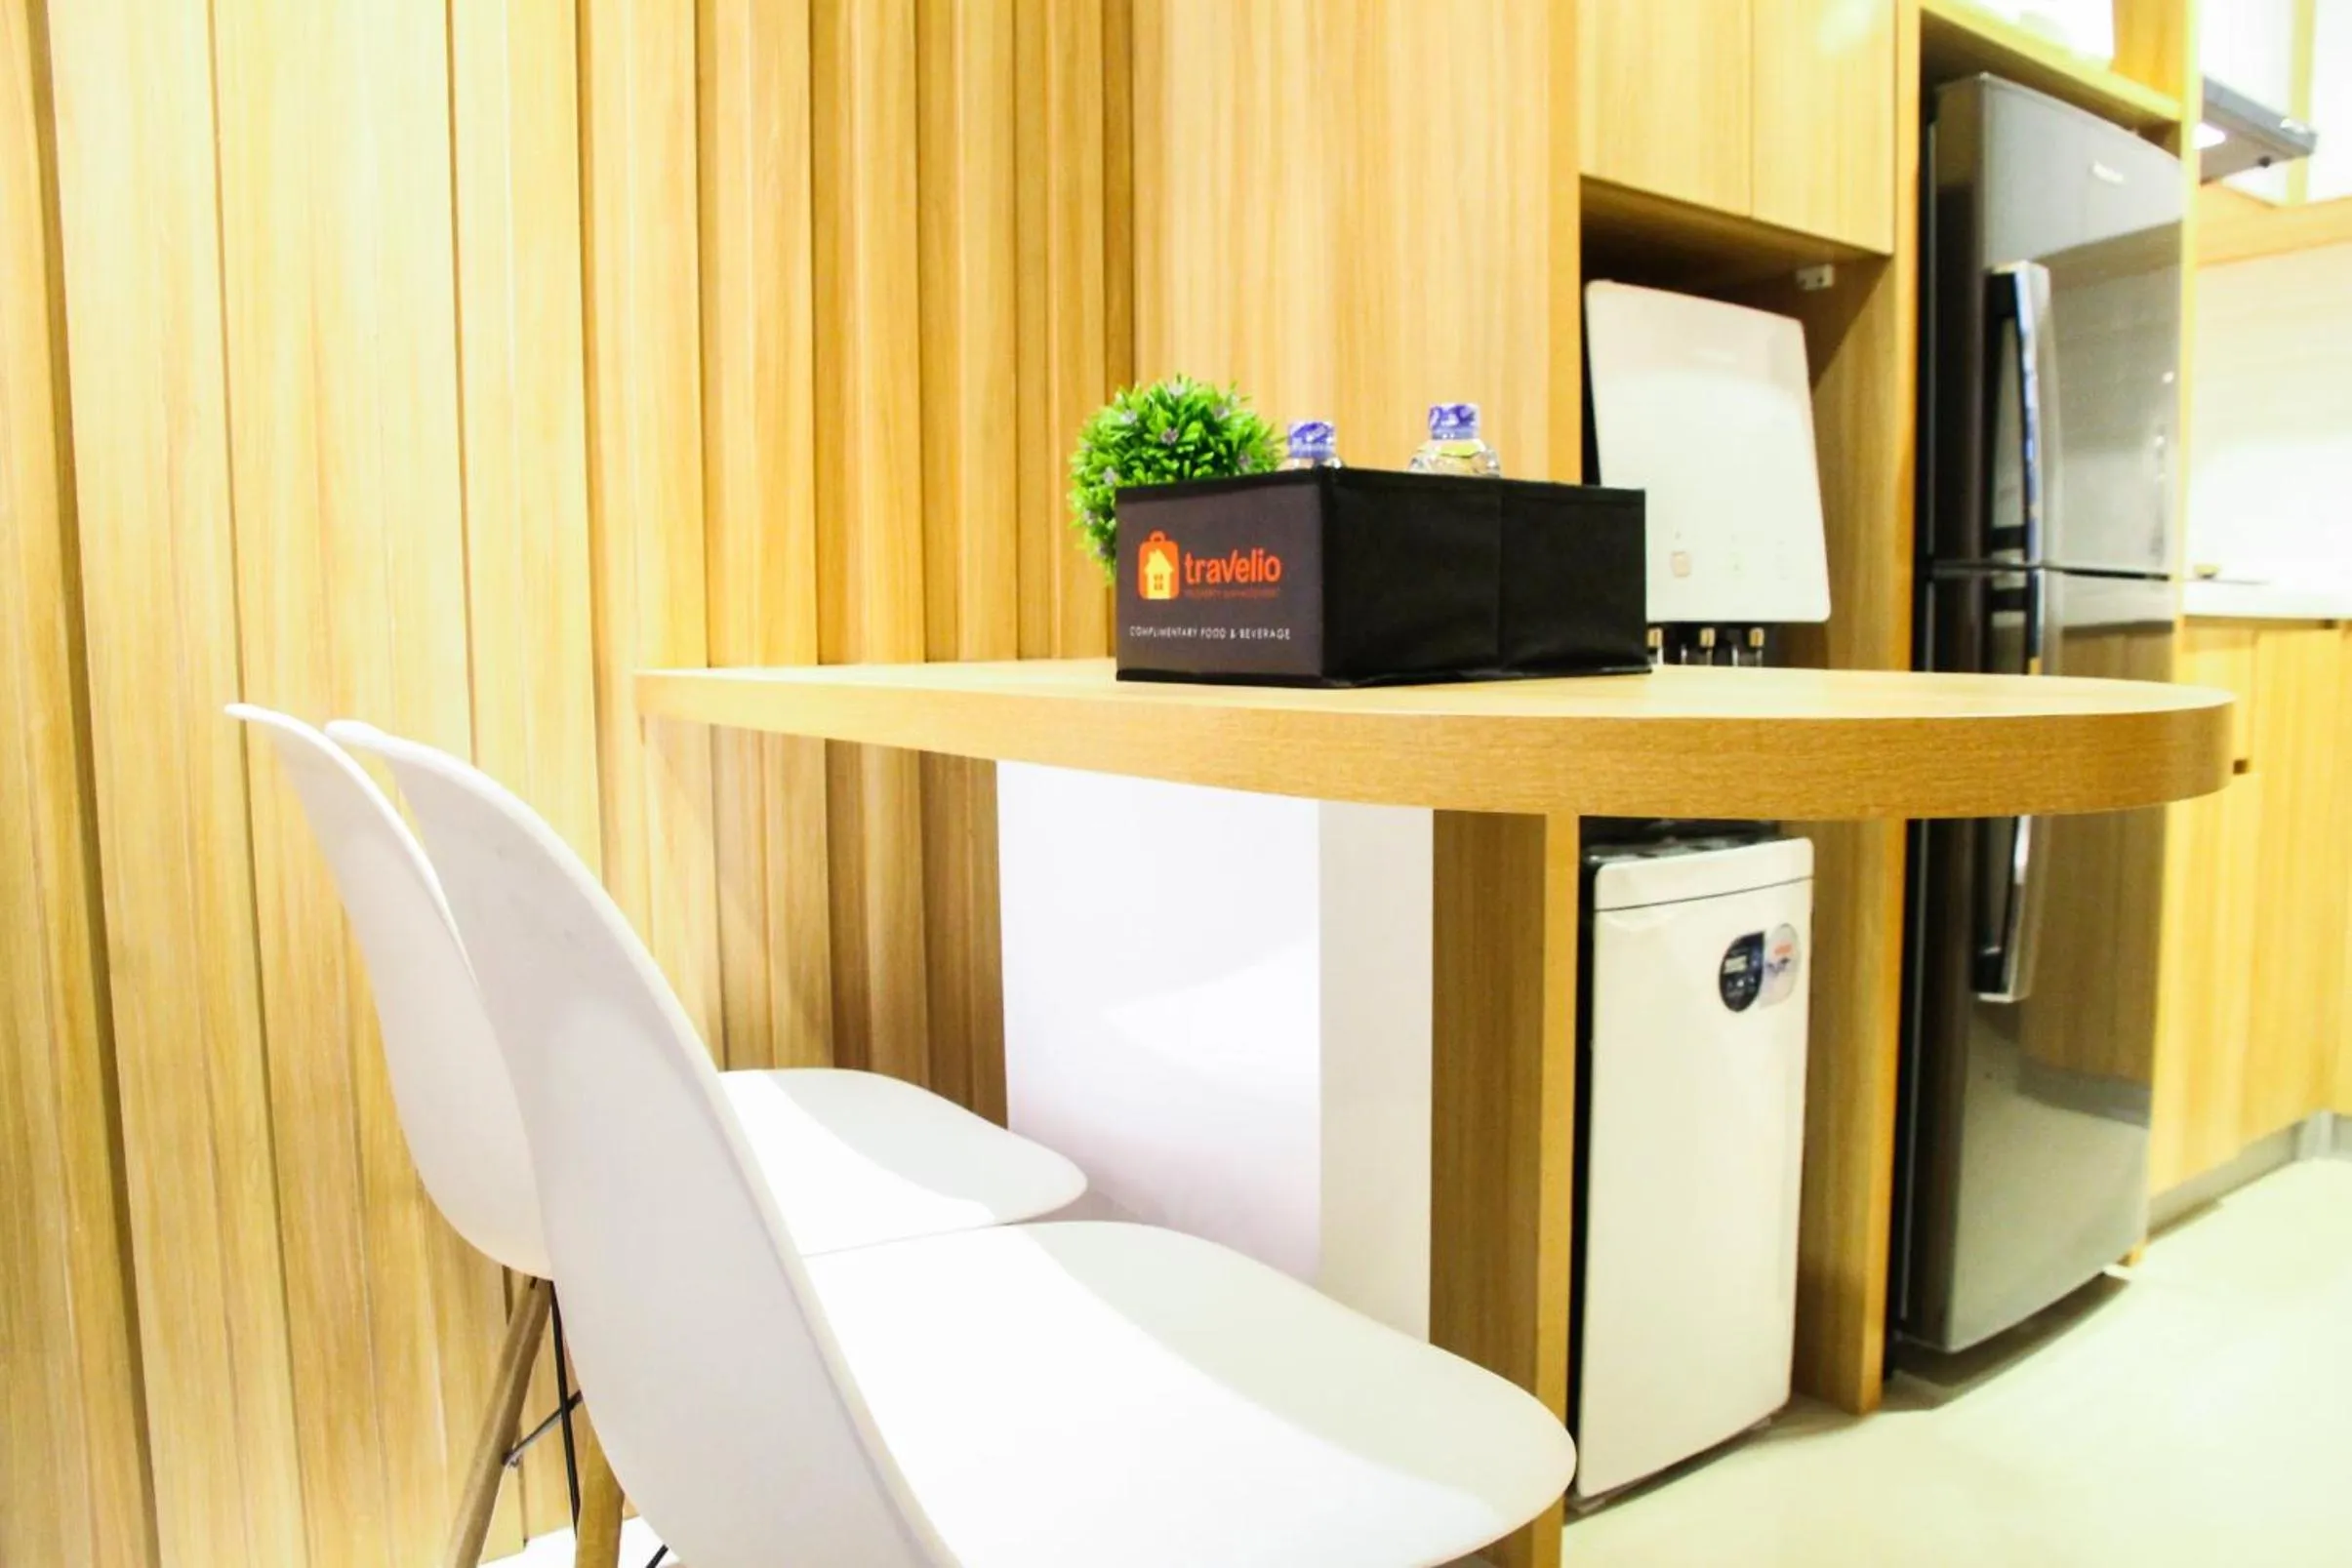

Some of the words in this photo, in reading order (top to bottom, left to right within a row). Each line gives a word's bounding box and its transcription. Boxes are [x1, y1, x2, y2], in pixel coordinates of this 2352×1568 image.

[1185, 548, 1281, 583] travelio
[1129, 625, 1197, 638] COMPLIMENTARY
[1200, 626, 1227, 639] FOOD
[1230, 626, 1237, 640] &
[1239, 626, 1291, 640] BEVERAGE
